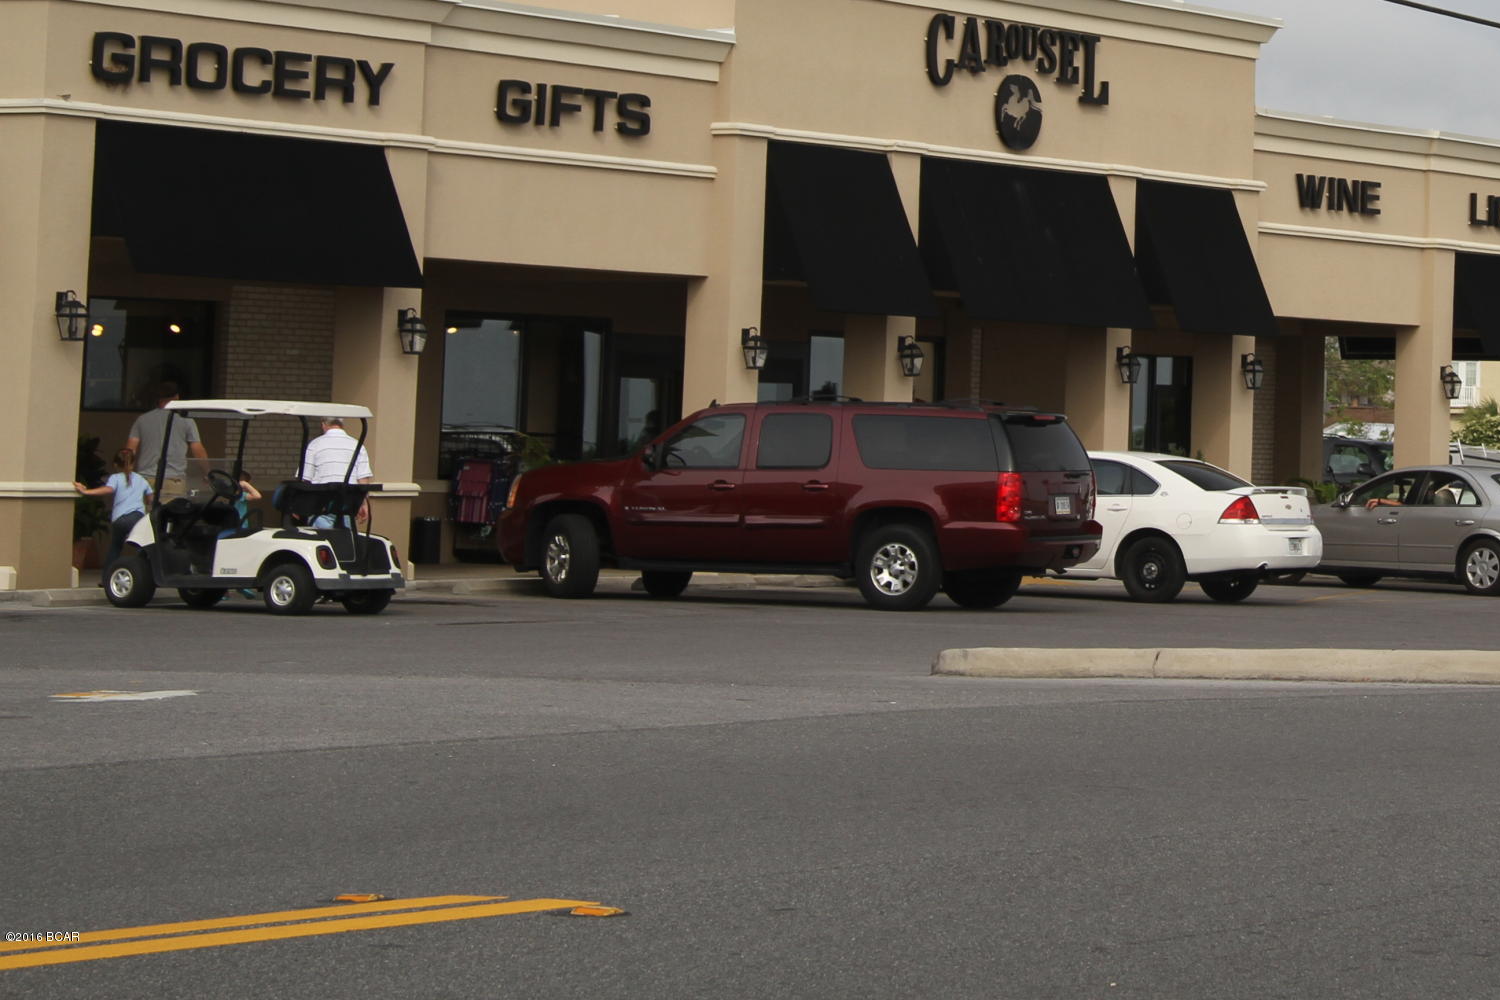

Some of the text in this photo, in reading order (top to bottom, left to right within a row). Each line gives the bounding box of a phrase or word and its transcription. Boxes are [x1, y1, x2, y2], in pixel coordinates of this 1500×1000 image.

[91, 31, 395, 106] GROCERY
[925, 13, 1109, 105] CAROUSEL
[496, 79, 651, 136] GIFTS
[1296, 173, 1382, 215] WINE
